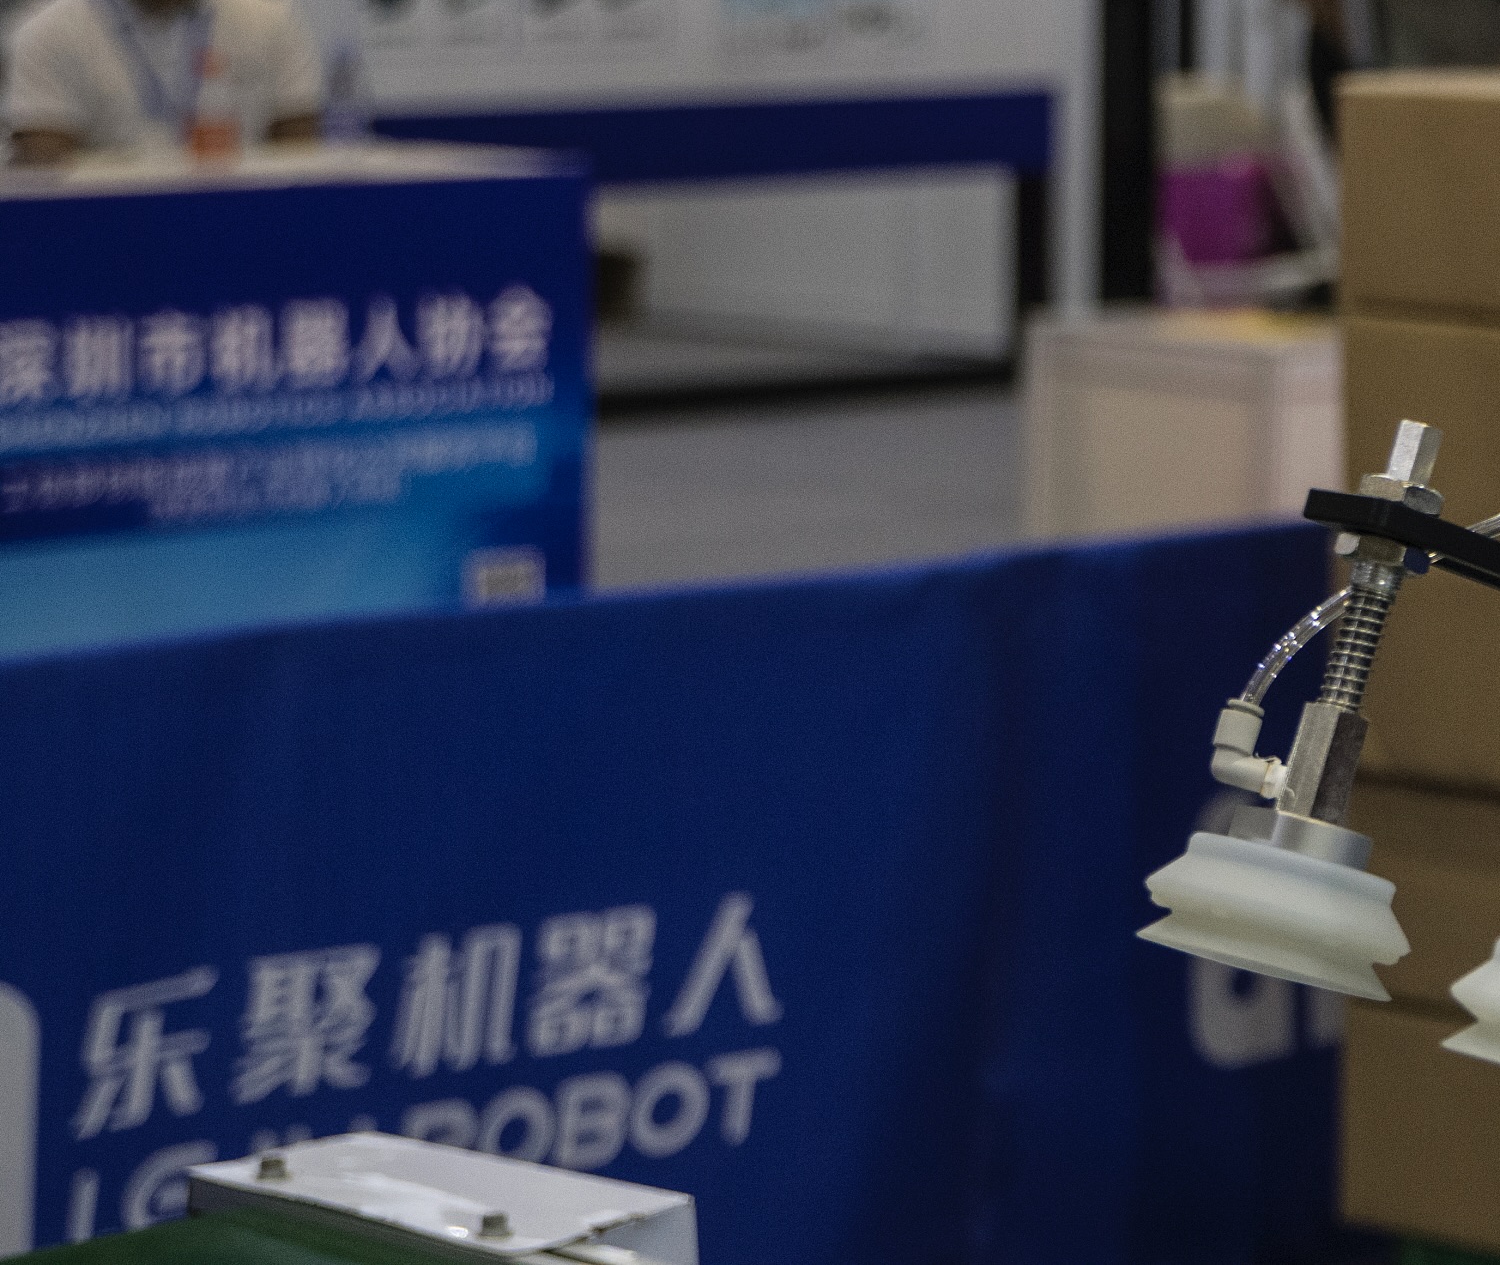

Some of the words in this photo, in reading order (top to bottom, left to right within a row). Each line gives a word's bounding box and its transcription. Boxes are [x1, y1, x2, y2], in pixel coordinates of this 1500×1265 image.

[70, 890, 783, 1139] 乐聚机器人
